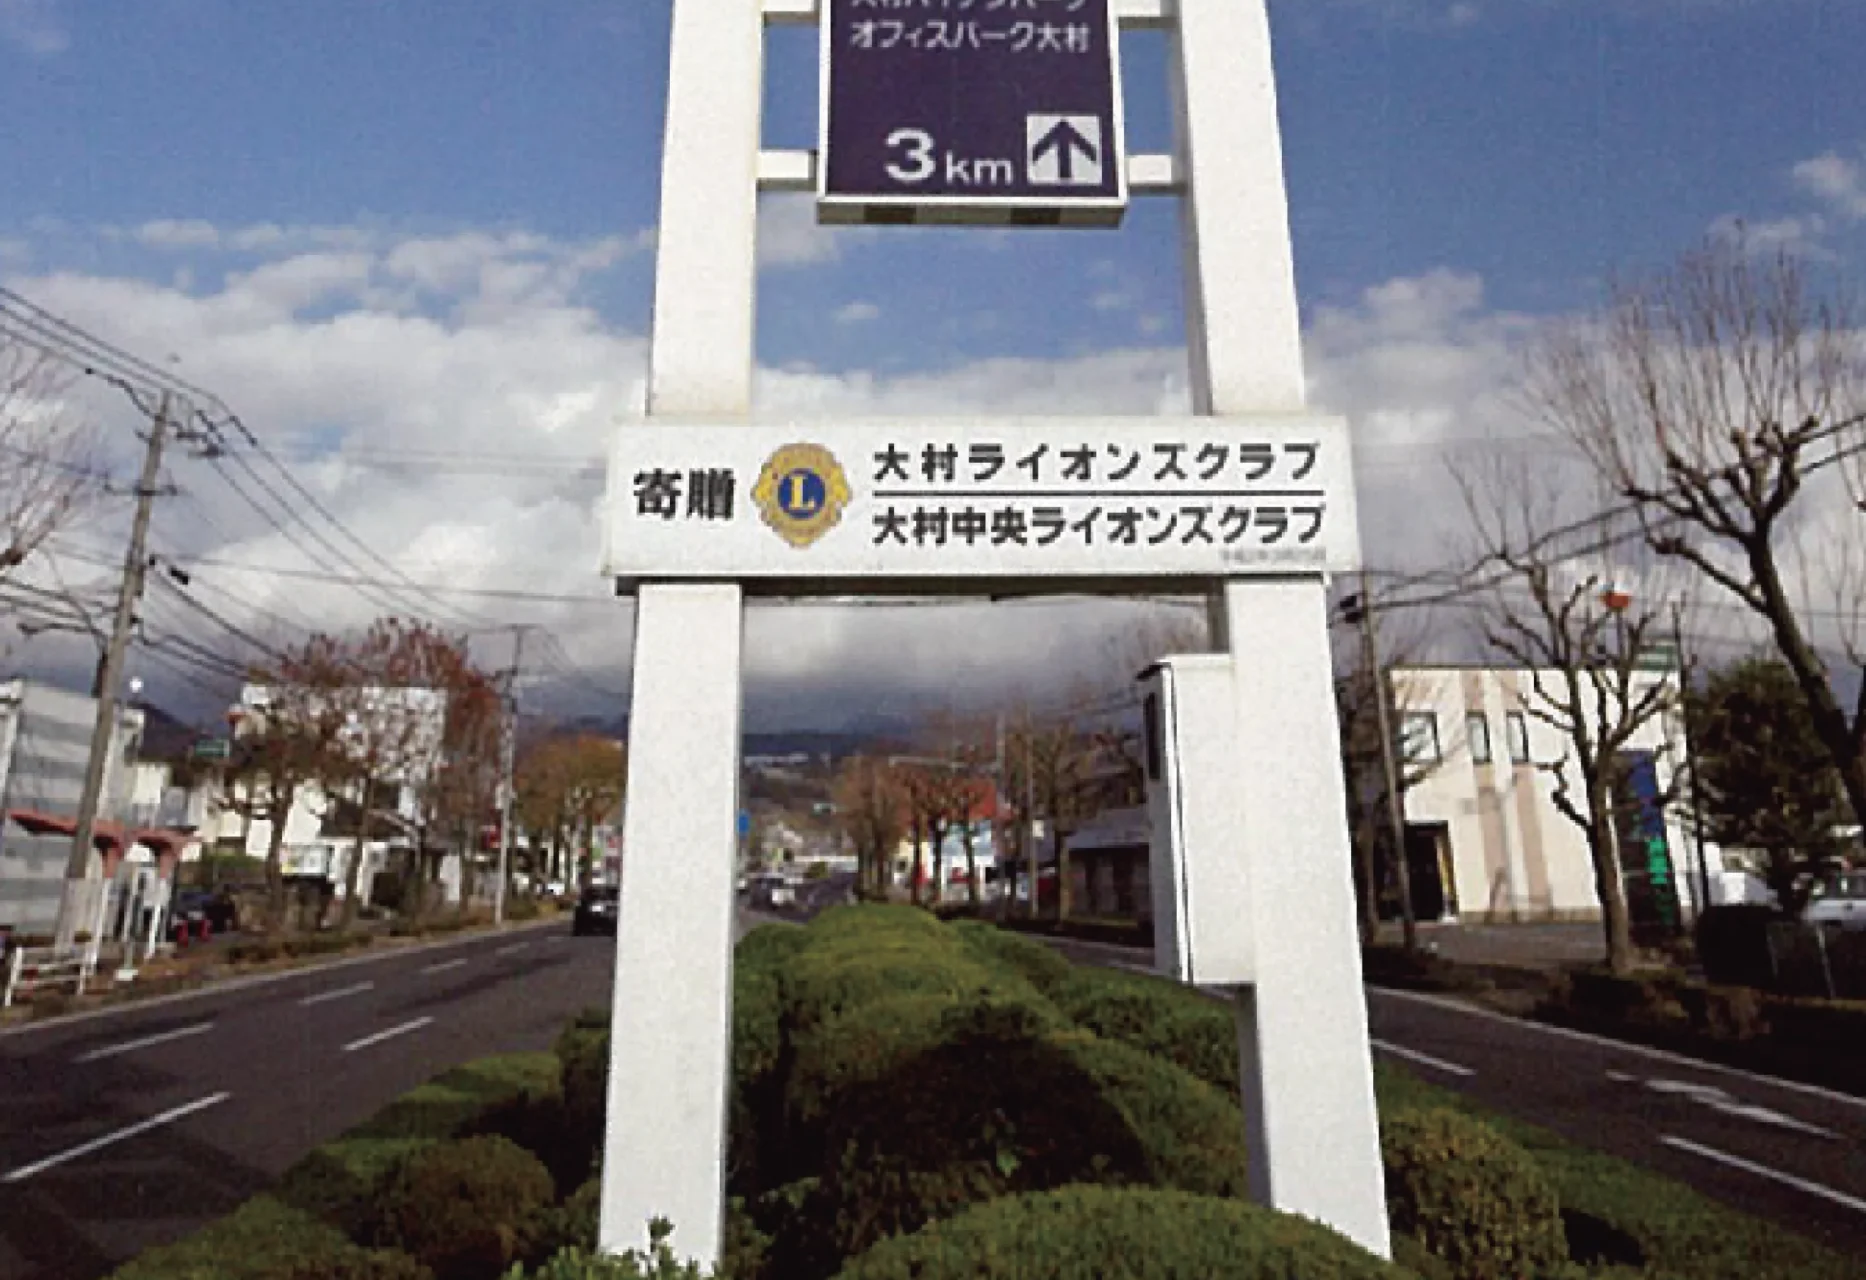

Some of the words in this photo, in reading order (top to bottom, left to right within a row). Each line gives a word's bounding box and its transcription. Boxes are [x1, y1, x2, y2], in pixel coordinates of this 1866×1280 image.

[851, 19, 1091, 53] オフィスパーク大村
[872, 440, 1321, 483] 大村ライオンズクラブ
[871, 502, 1327, 547] 大村中央ライオンズクラブ
